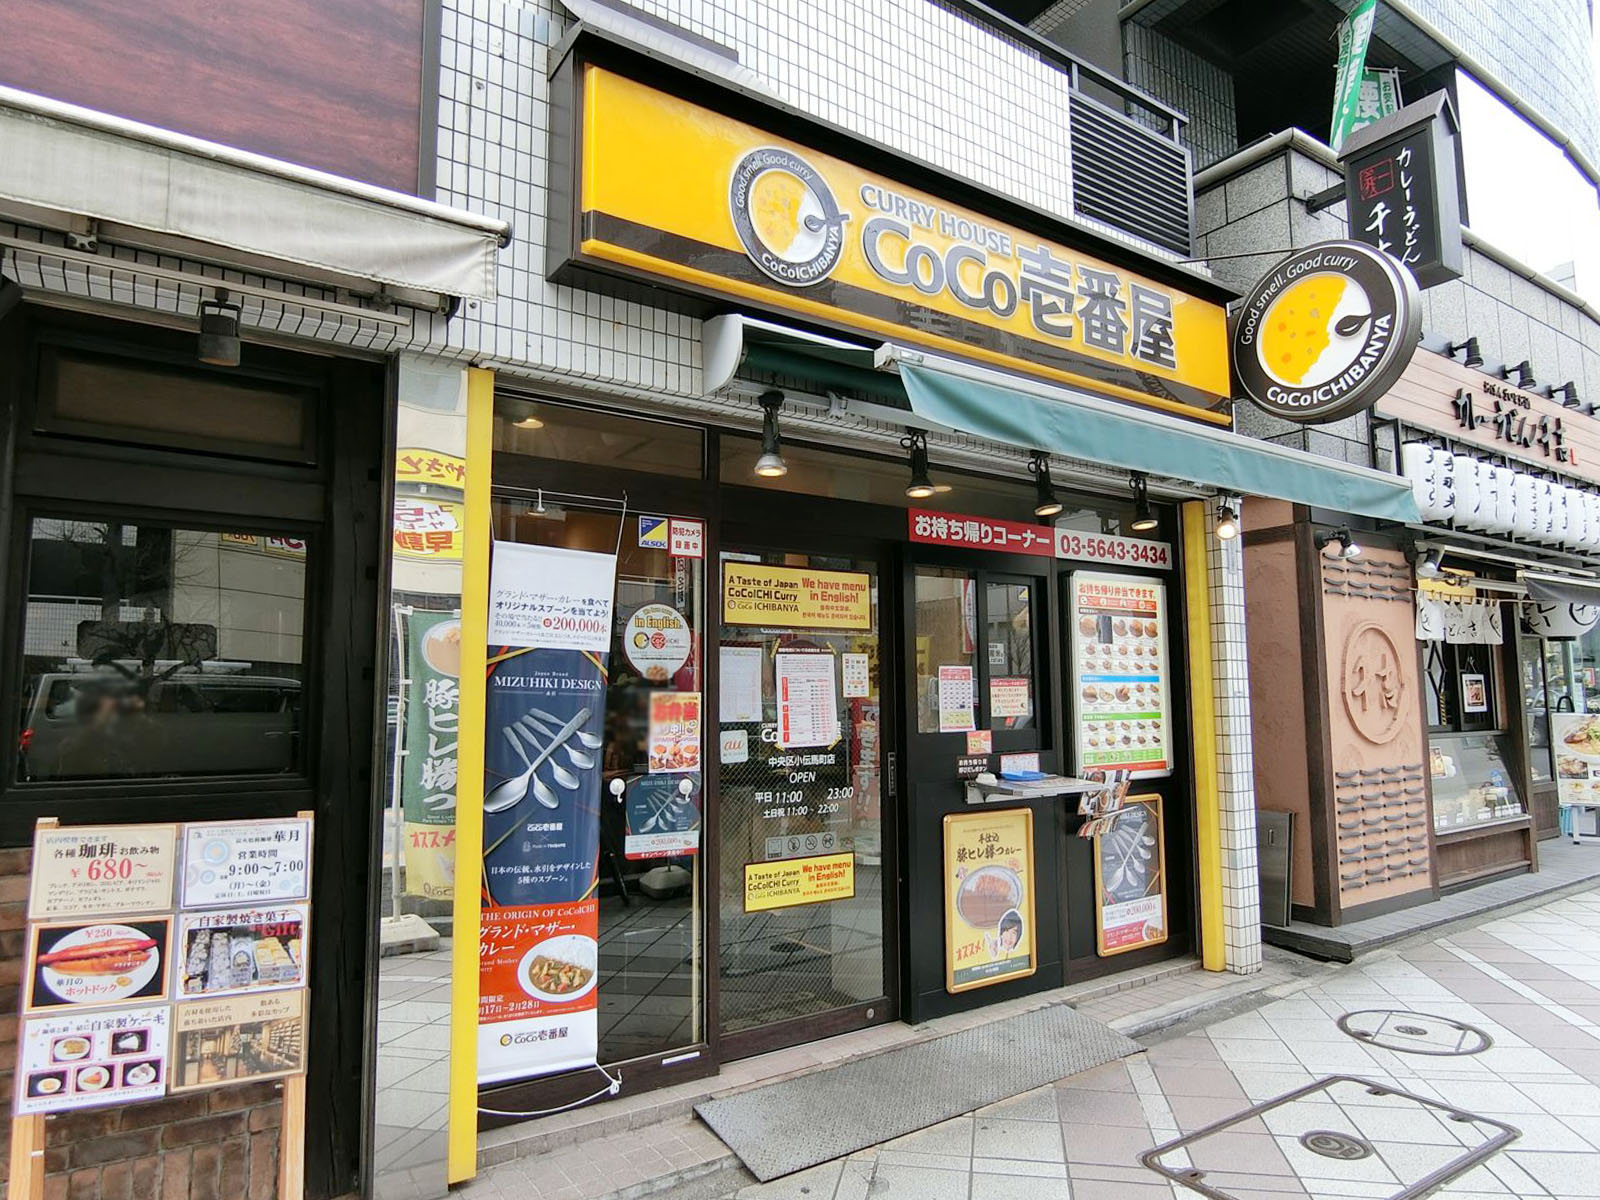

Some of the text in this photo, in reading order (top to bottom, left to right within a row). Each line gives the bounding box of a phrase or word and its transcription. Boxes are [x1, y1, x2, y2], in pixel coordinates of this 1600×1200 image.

[735, 175, 745, 208] Good
[762, 153, 788, 165] Good
[789, 159, 813, 180] curry
[1396, 147, 1421, 265] カレーうどん
[860, 182, 1012, 258] CURRY HOUSE
[1241, 253, 1359, 345] Good smell. Good curry
[1266, 313, 1392, 407] CoCoICHIBANYA
[672, 526, 701, 538] 防犯カメラ
[914, 515, 1050, 549] お持ち帰りコーナー
[640, 540, 666, 548] ALSOK
[1060, 534, 1168, 565] 03-5643-3434
[728, 576, 799, 590] A Taste of Japan
[801, 577, 867, 592] We have menu
[728, 587, 798, 602] CoCoICHI Curry
[810, 590, 859, 604] in English!
[754, 601, 799, 613] ICHIBANYA
[494, 676, 602, 690] MIZUHIKI DESIGN
[768, 754, 836, 768] 中央区小伝馬町店
[789, 771, 816, 783] OPEN
[755, 786, 854, 804] 平日 11:00 23:00
[787, 806, 808, 816] 11:00
[818, 803, 839, 814] 22:00
[237, 849, 279, 860] 営業時間
[802, 860, 851, 873] We have menu
[782, 878, 800, 889] Curry
[808, 873, 816, 882] in
[199, 909, 292, 928] 自家製焼き菓子
[503, 909, 540, 921] ORIGIN
[542, 907, 557, 918] OF
[479, 943, 516, 957] カレー
